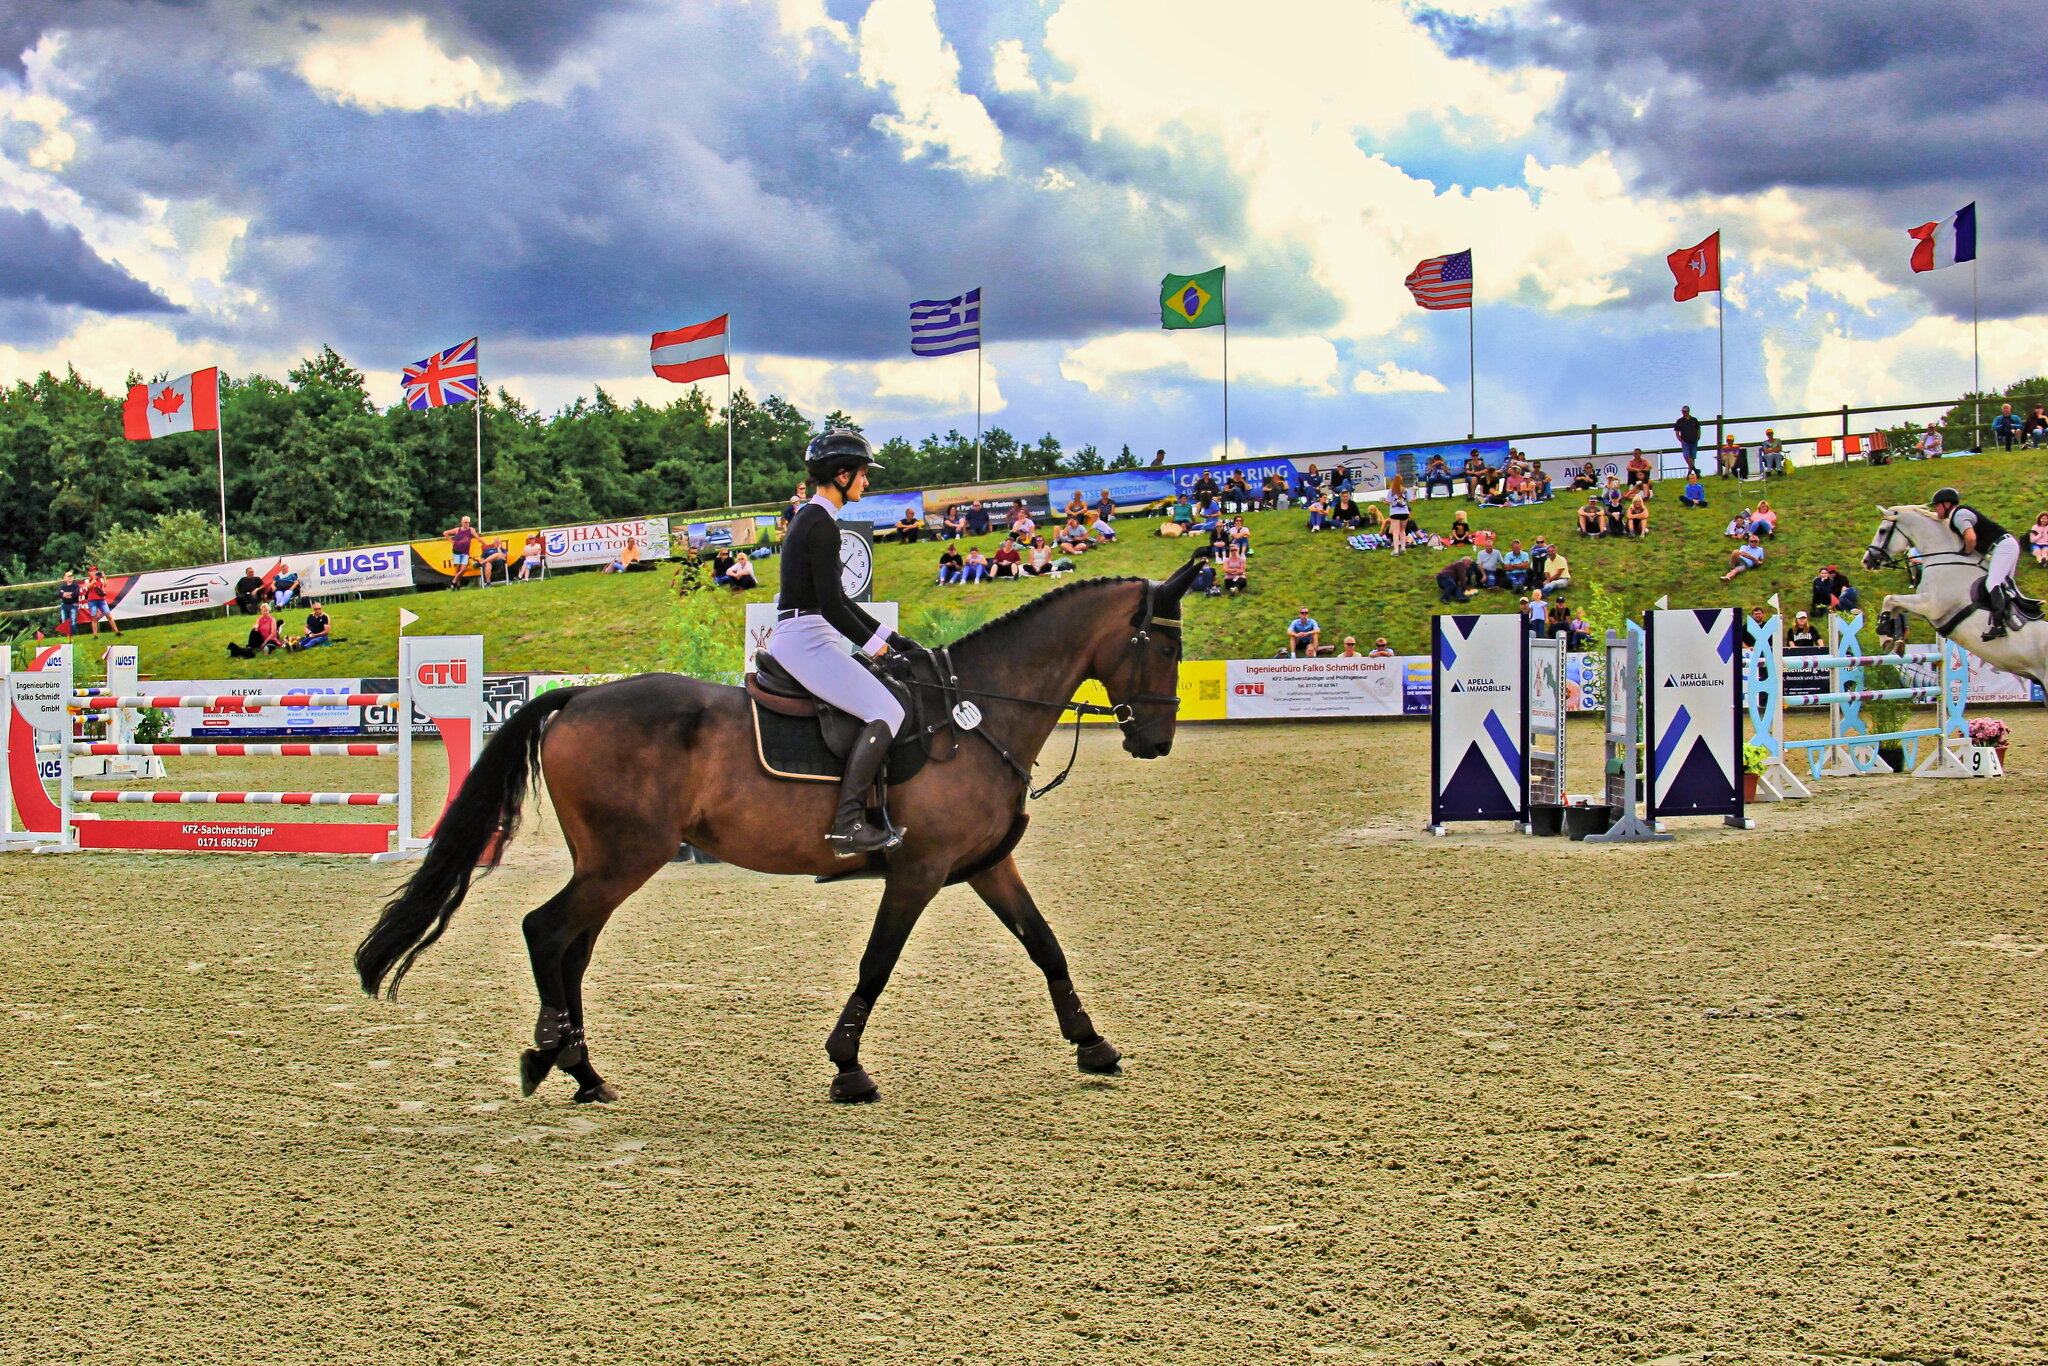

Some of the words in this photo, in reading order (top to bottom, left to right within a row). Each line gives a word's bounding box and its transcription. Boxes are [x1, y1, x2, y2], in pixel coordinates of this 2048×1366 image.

[1109, 484, 1148, 497] TROPHY
[856, 509, 895, 521] TROPHY
[573, 522, 648, 542] HANSE
[572, 542, 602, 552] CITY
[857, 549, 863, 557] 2
[141, 587, 209, 606] THEURER
[418, 659, 467, 685] GTÜ
[1246, 664, 1301, 675] Ingenieurbüro
[1302, 664, 1324, 673] Falko
[1326, 663, 1359, 672] Schmidt
[1360, 663, 1385, 671] GmbH
[16, 681, 60, 691] Ingenieurbüro
[1235, 682, 1264, 695] GTÜ
[17, 693, 34, 701] Falko
[35, 693, 60, 701] Schmidt
[145, 759, 150, 775] 1
[1972, 752, 1981, 771] 9
[182, 825, 275, 836] KFZ-Sachverständiger
[197, 838, 217, 847] 0171
[220, 839, 259, 848] 6862967
